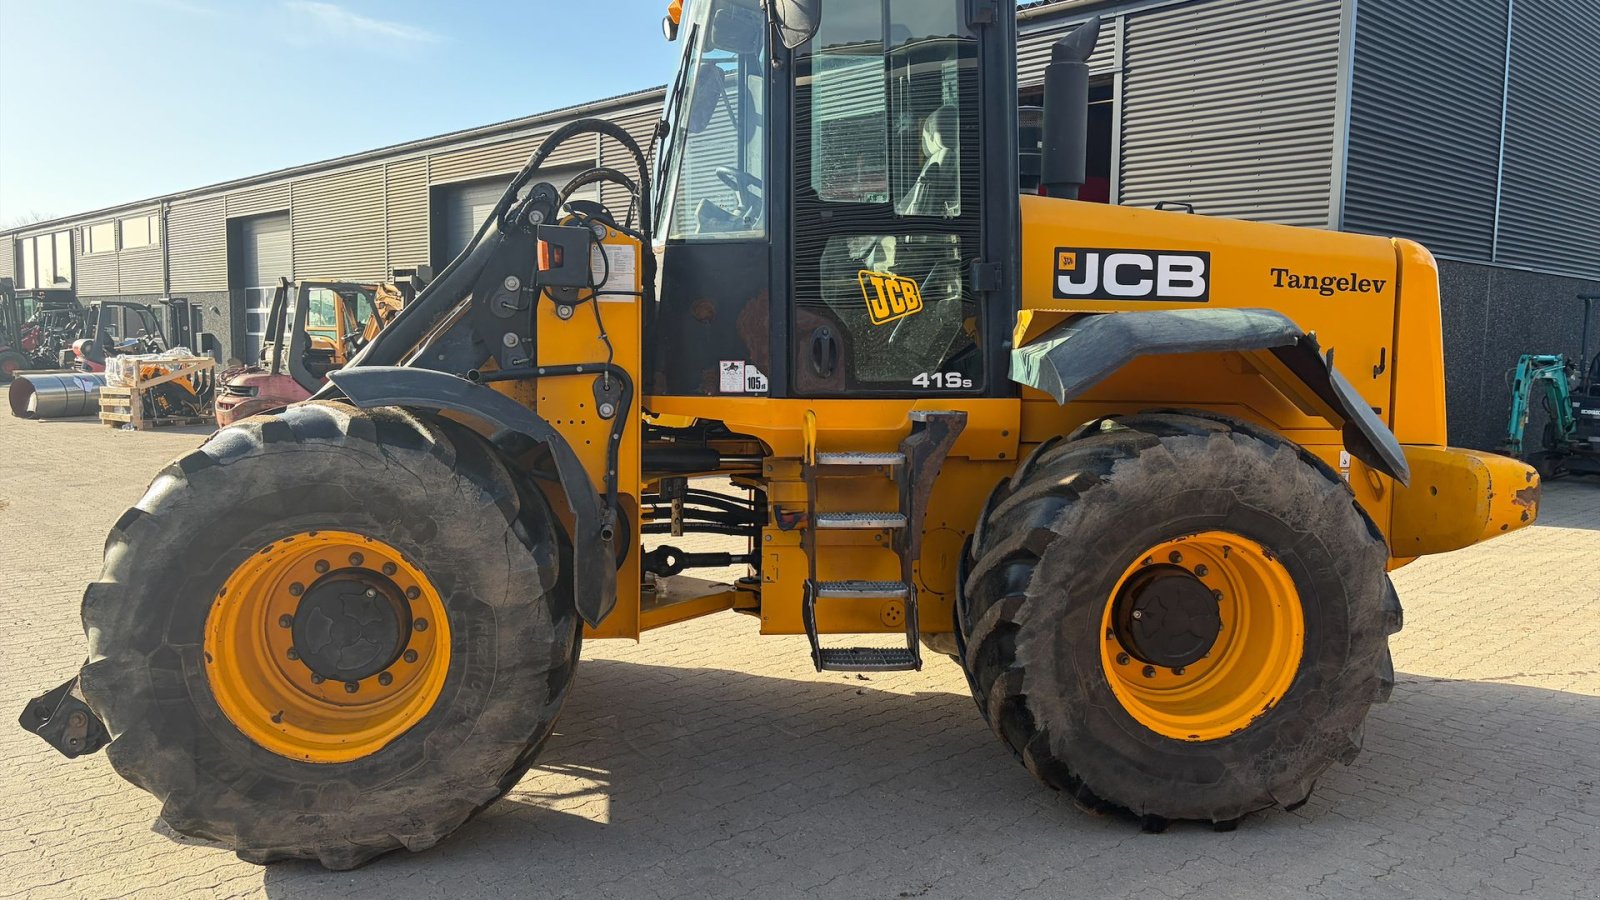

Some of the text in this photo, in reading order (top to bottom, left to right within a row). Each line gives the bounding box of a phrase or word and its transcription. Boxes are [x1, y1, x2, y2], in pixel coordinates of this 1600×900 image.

[1058, 252, 1205, 297] JCB
[1270, 268, 1386, 295] Tangelev
[869, 275, 919, 319] JCB
[747, 376, 761, 390] 105
